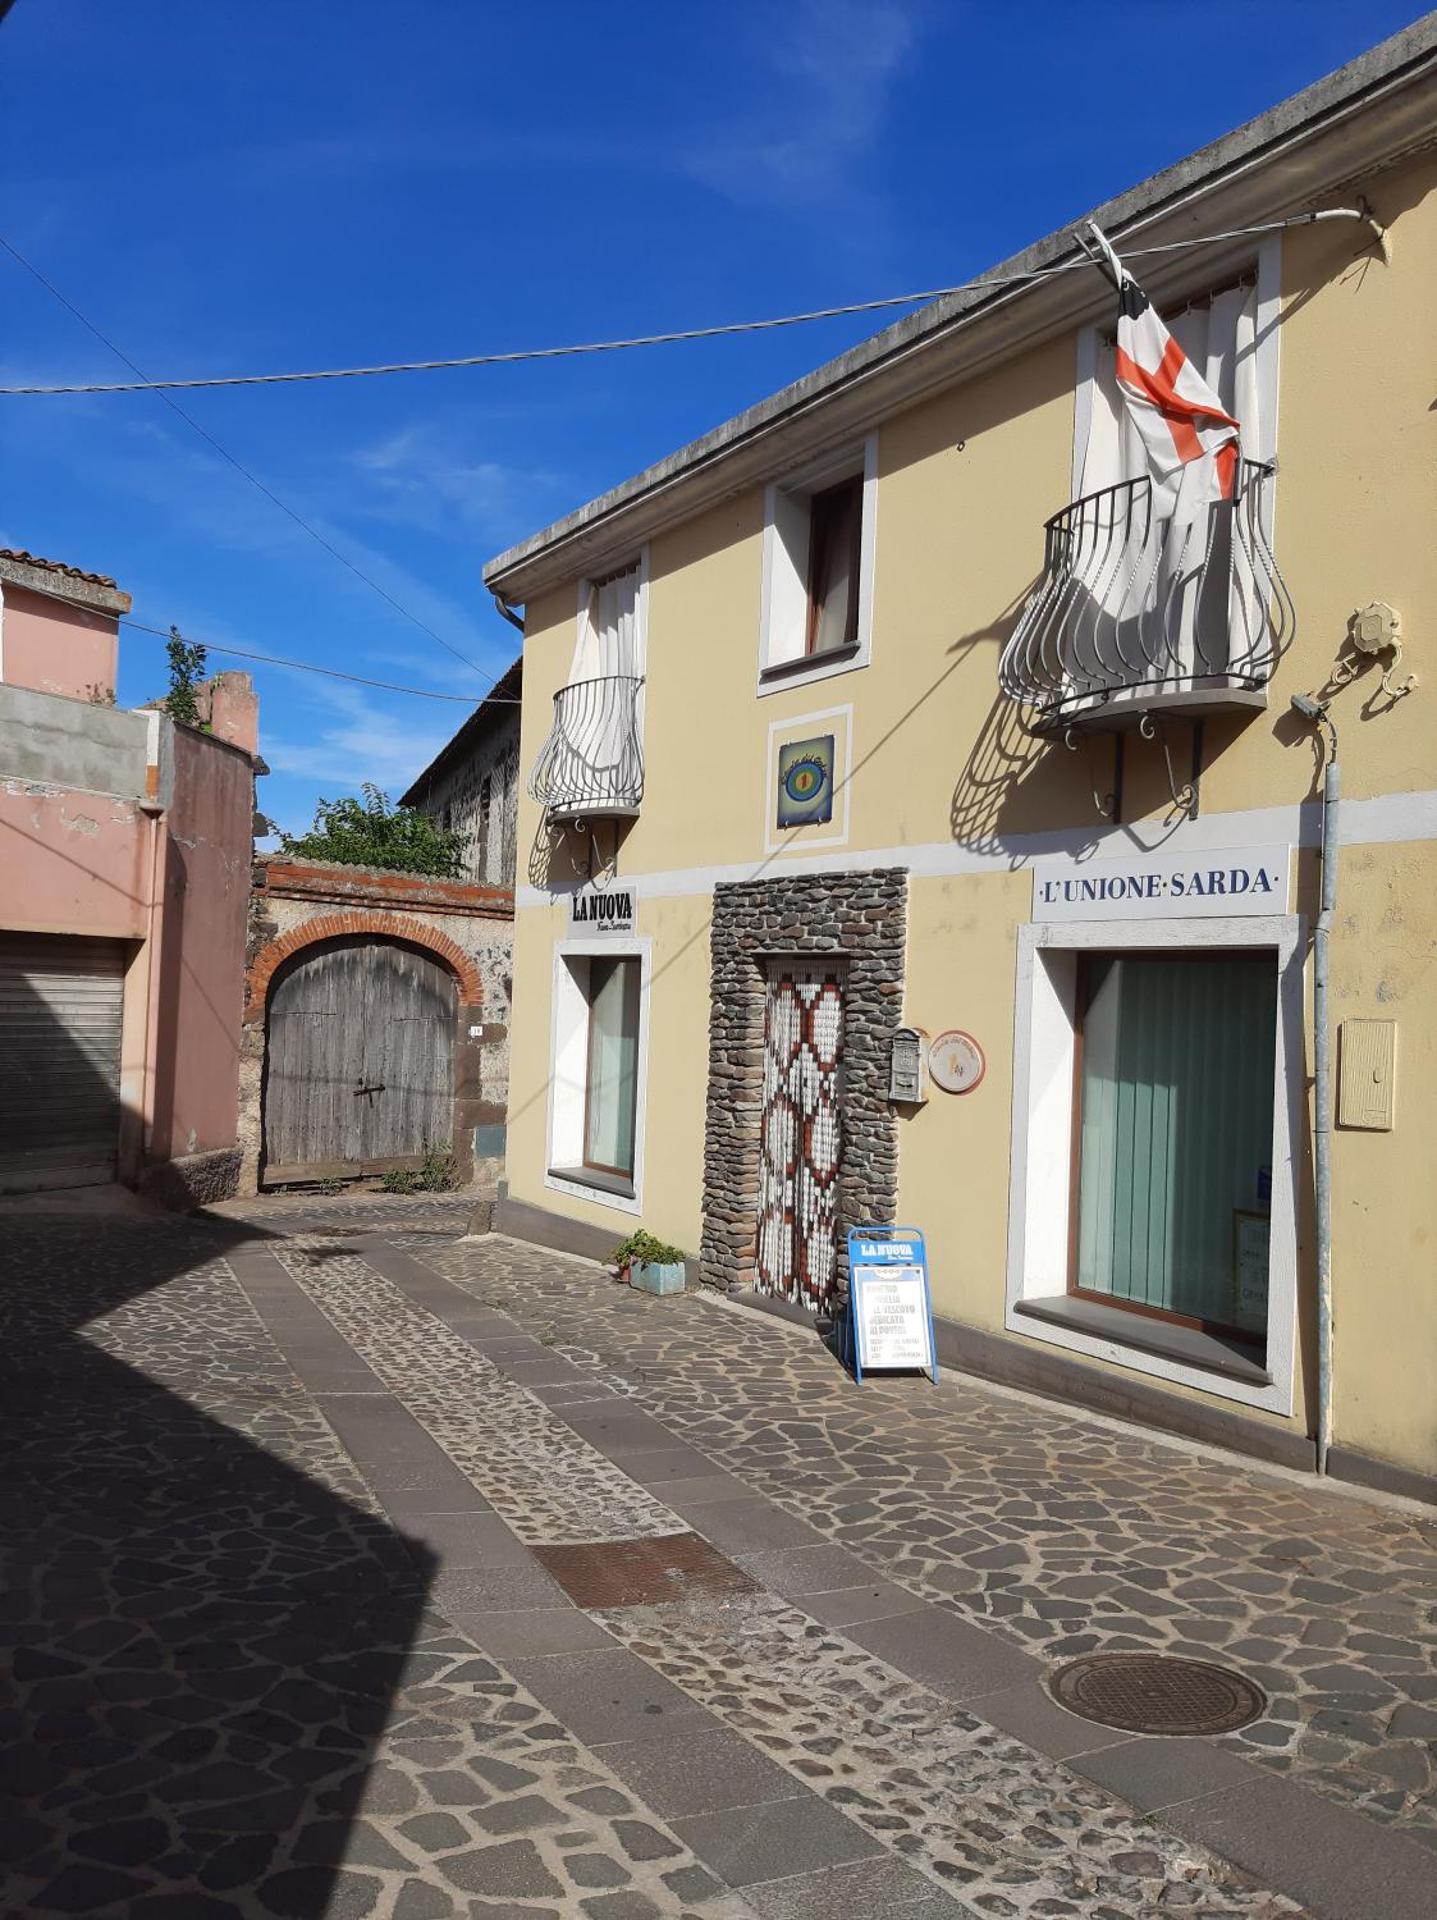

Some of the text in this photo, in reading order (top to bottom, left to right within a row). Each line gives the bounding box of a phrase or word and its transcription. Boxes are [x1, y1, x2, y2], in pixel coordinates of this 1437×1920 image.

[573, 893, 632, 922] LA NUOVA
[861, 1244, 914, 1256] LA NUOVA
